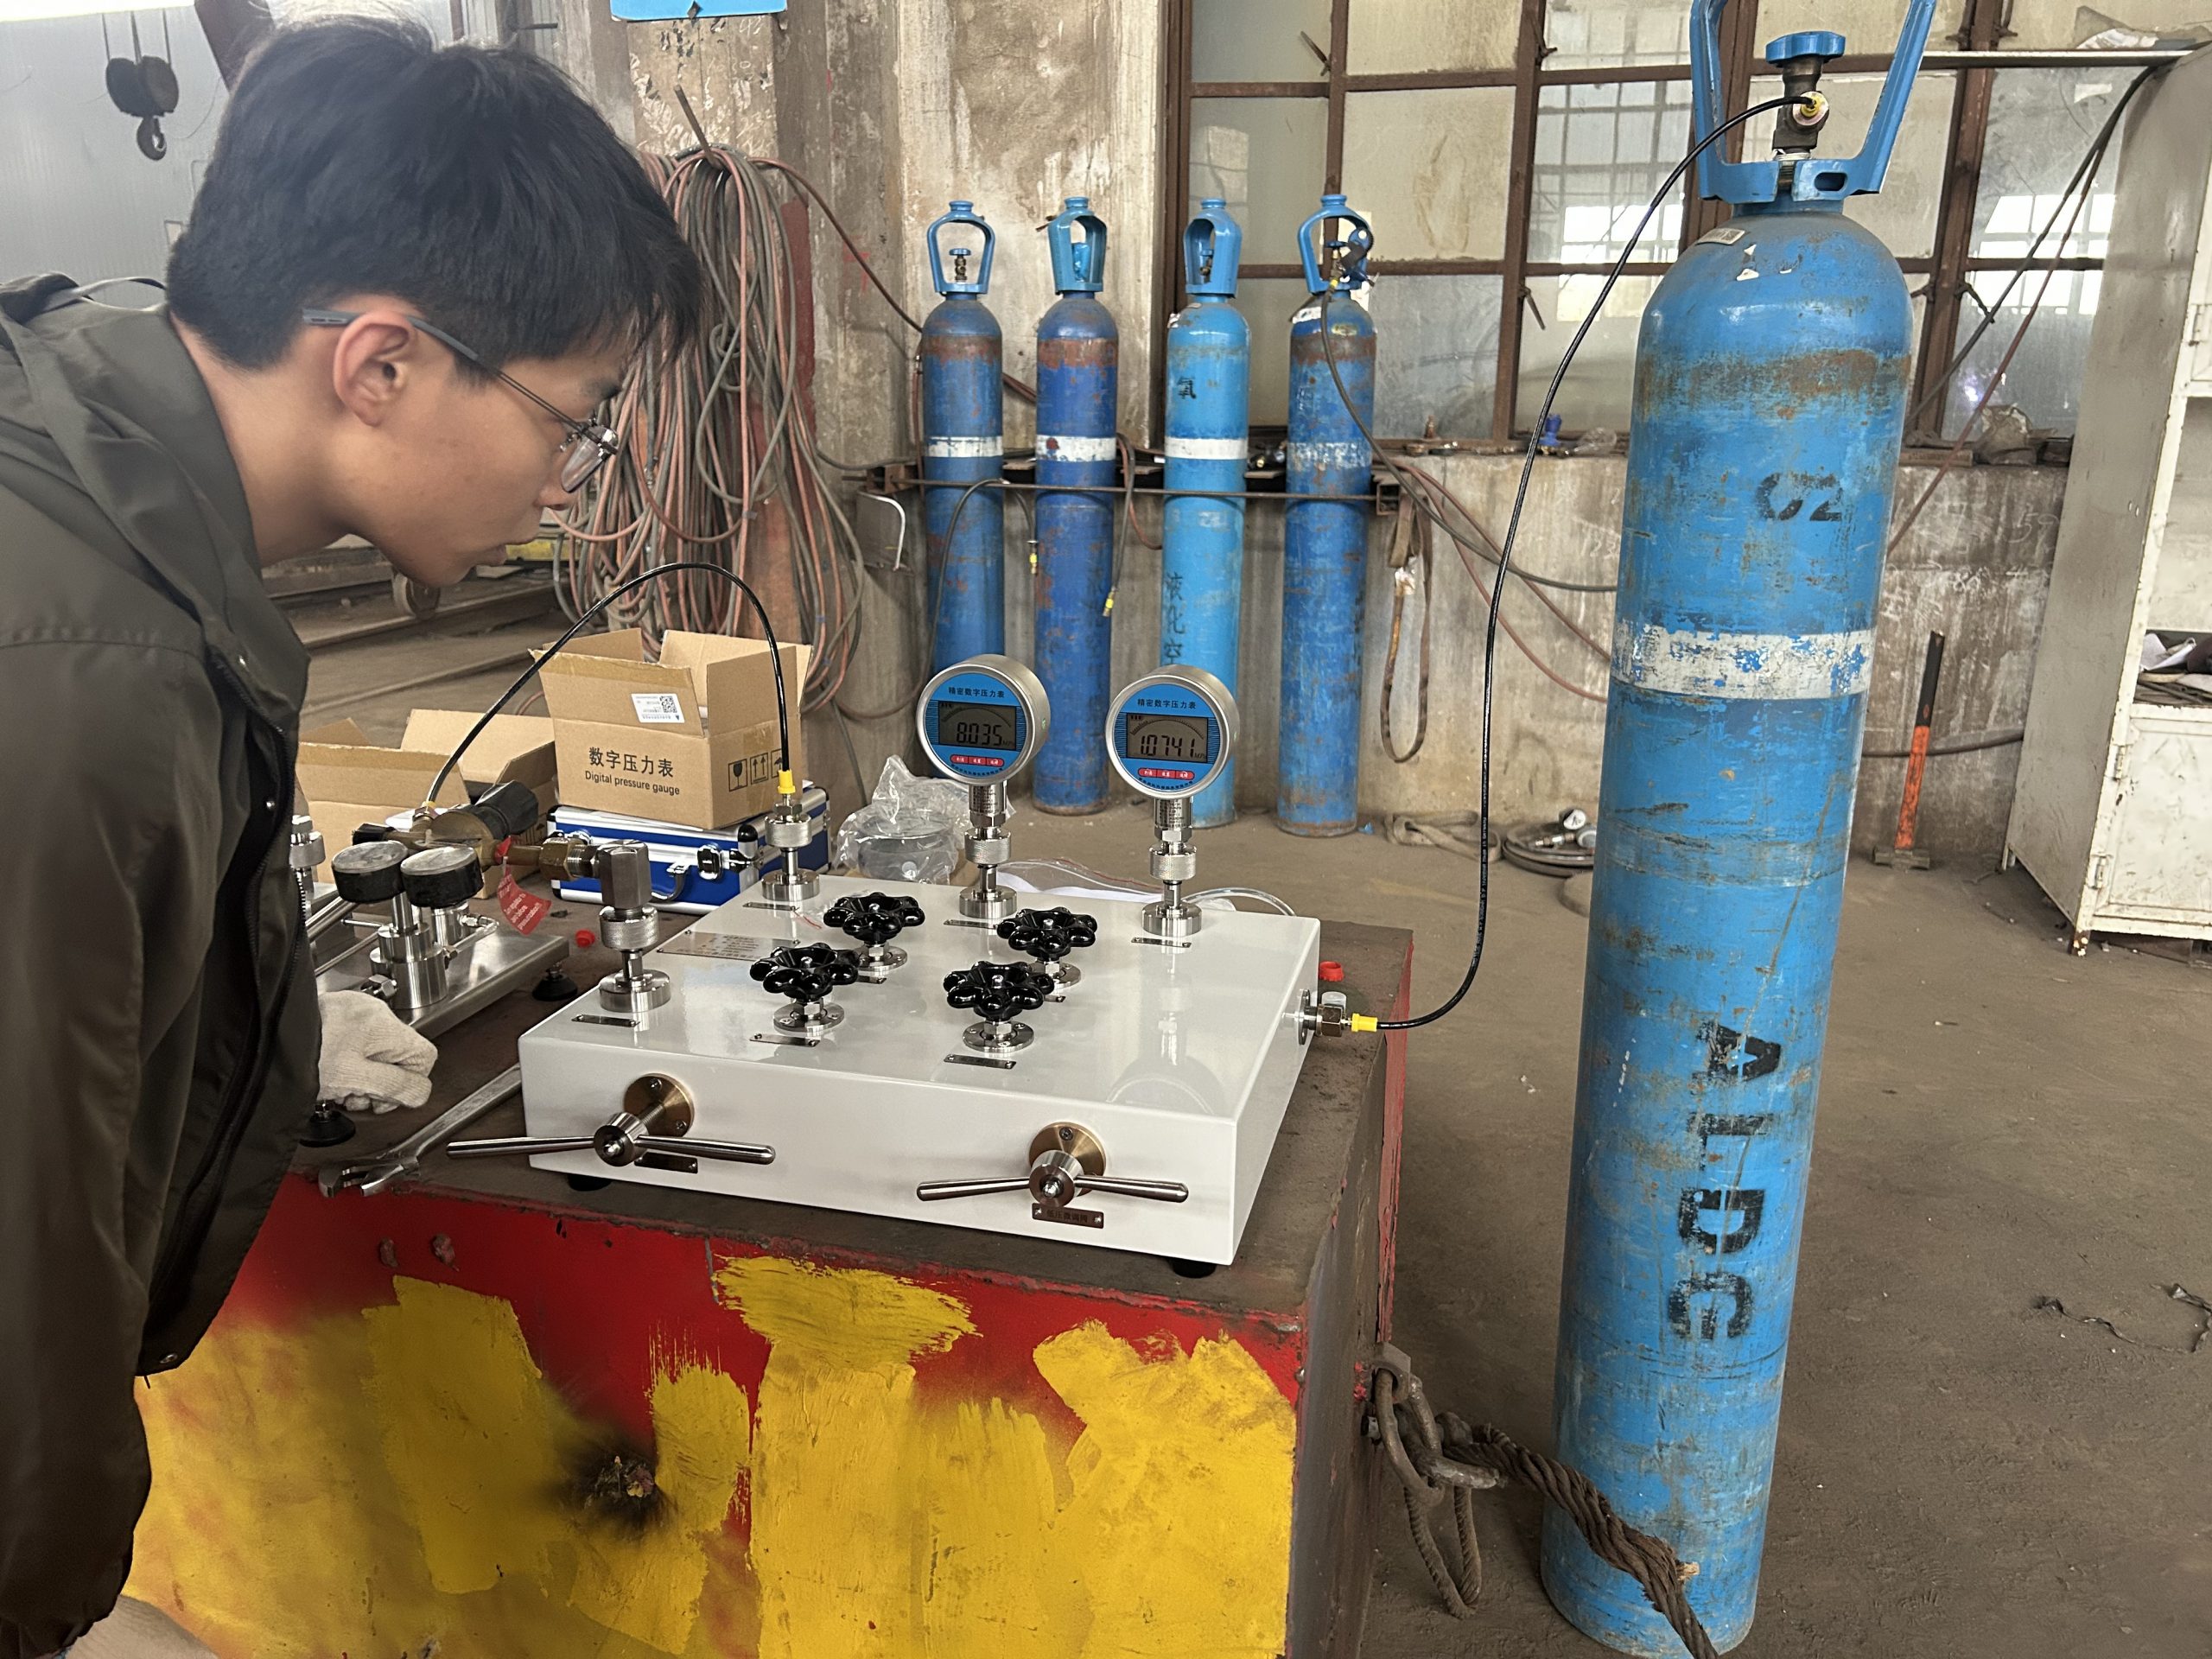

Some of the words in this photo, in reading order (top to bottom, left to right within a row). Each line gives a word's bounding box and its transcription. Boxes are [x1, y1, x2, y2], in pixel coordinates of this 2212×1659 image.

[949, 686, 1005, 698] 精密数字压力表
[1137, 698, 1197, 709] 精密数字压力表
[588, 747, 674, 778] 数字压力表
[585, 770, 613, 784] Digital
[614, 777, 651, 790] pressure
[652, 783, 680, 796] gauge
